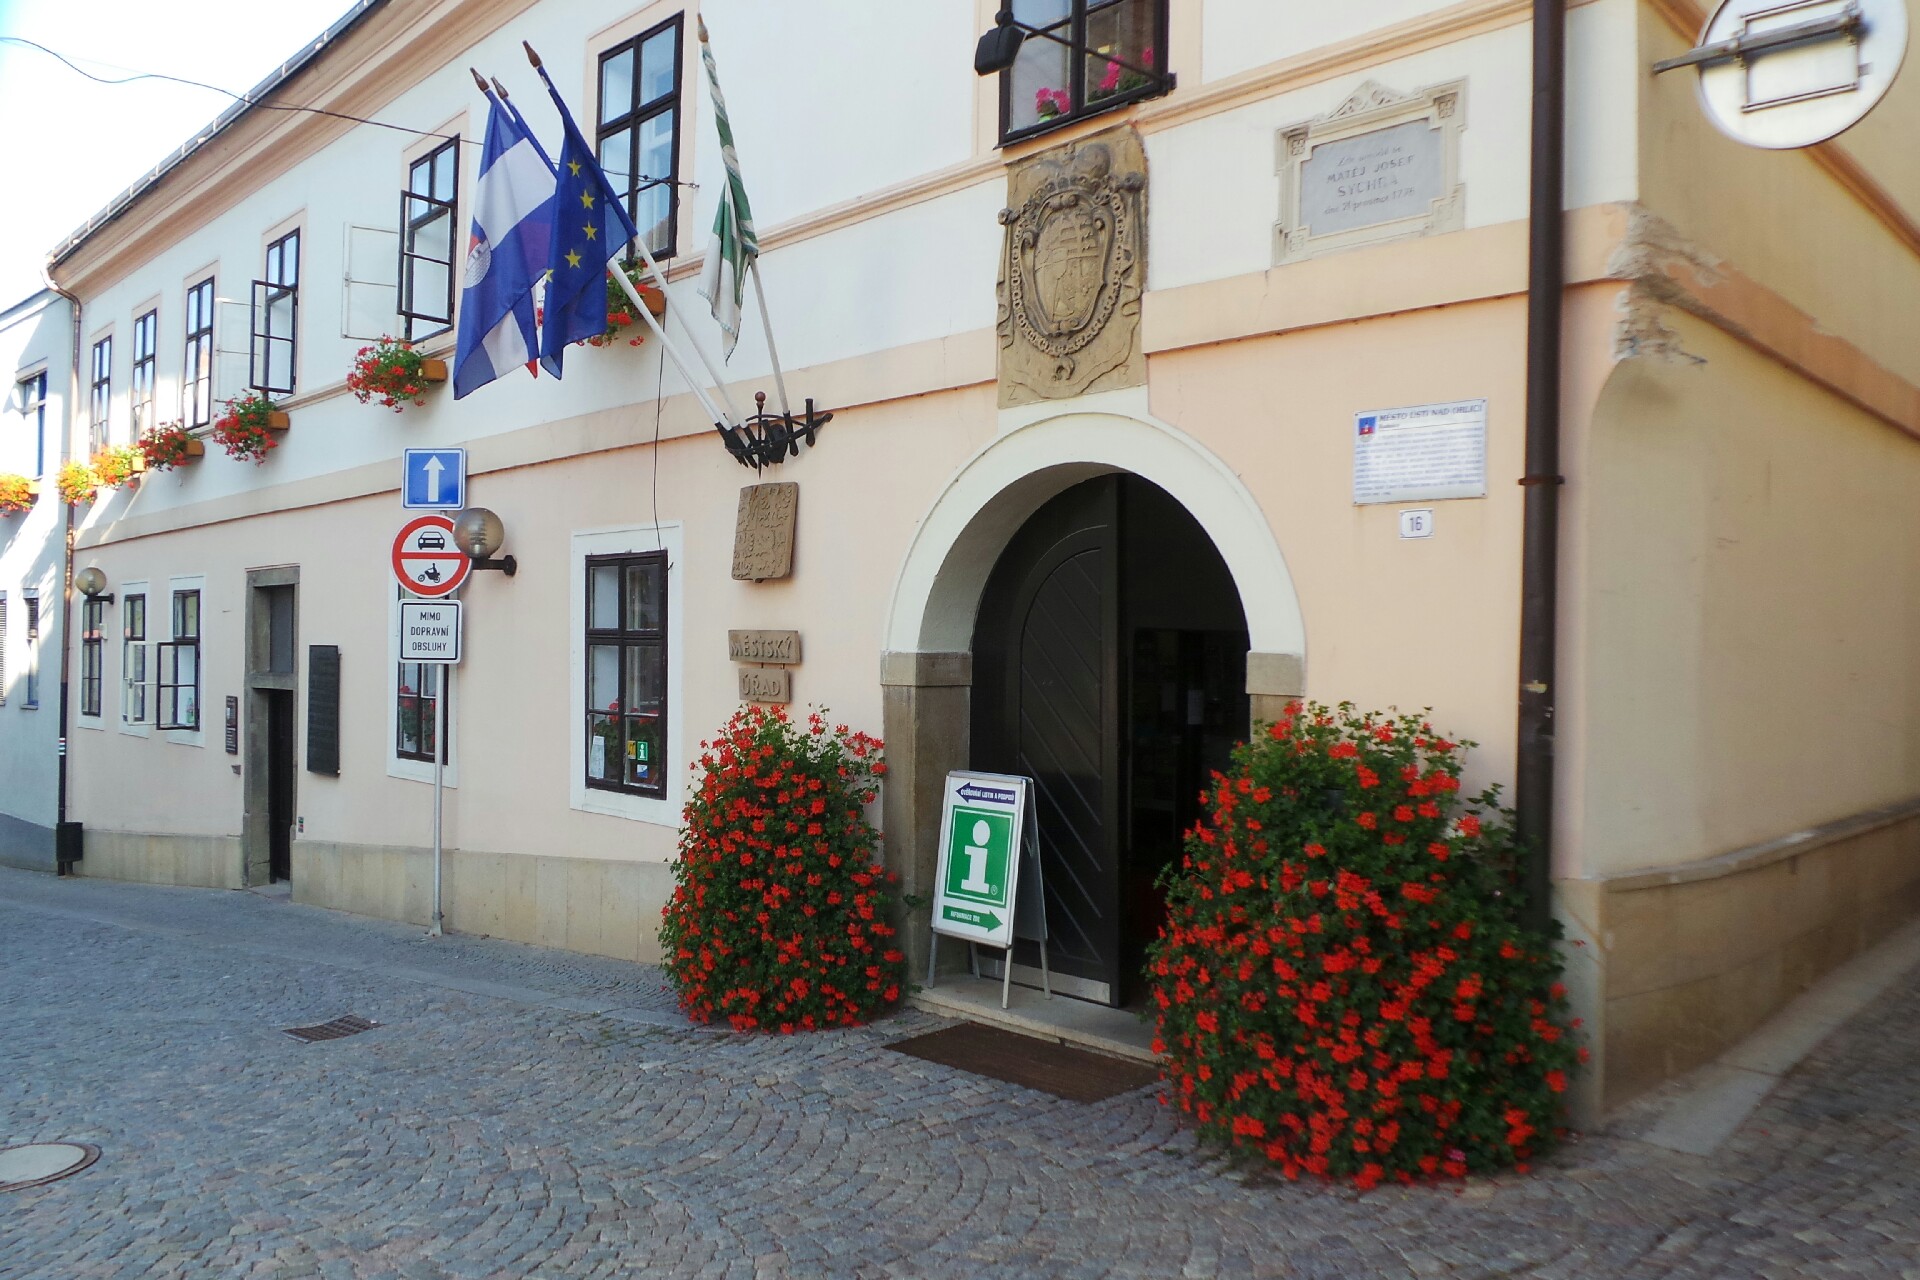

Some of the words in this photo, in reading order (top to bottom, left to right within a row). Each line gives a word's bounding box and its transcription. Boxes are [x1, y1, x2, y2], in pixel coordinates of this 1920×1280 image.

[1374, 154, 1415, 173] JOSEF
[1409, 516, 1423, 532] 16
[420, 611, 441, 621] MIMO
[410, 625, 449, 637] DOPRAVNÍ
[412, 641, 447, 652] OBSLUHY
